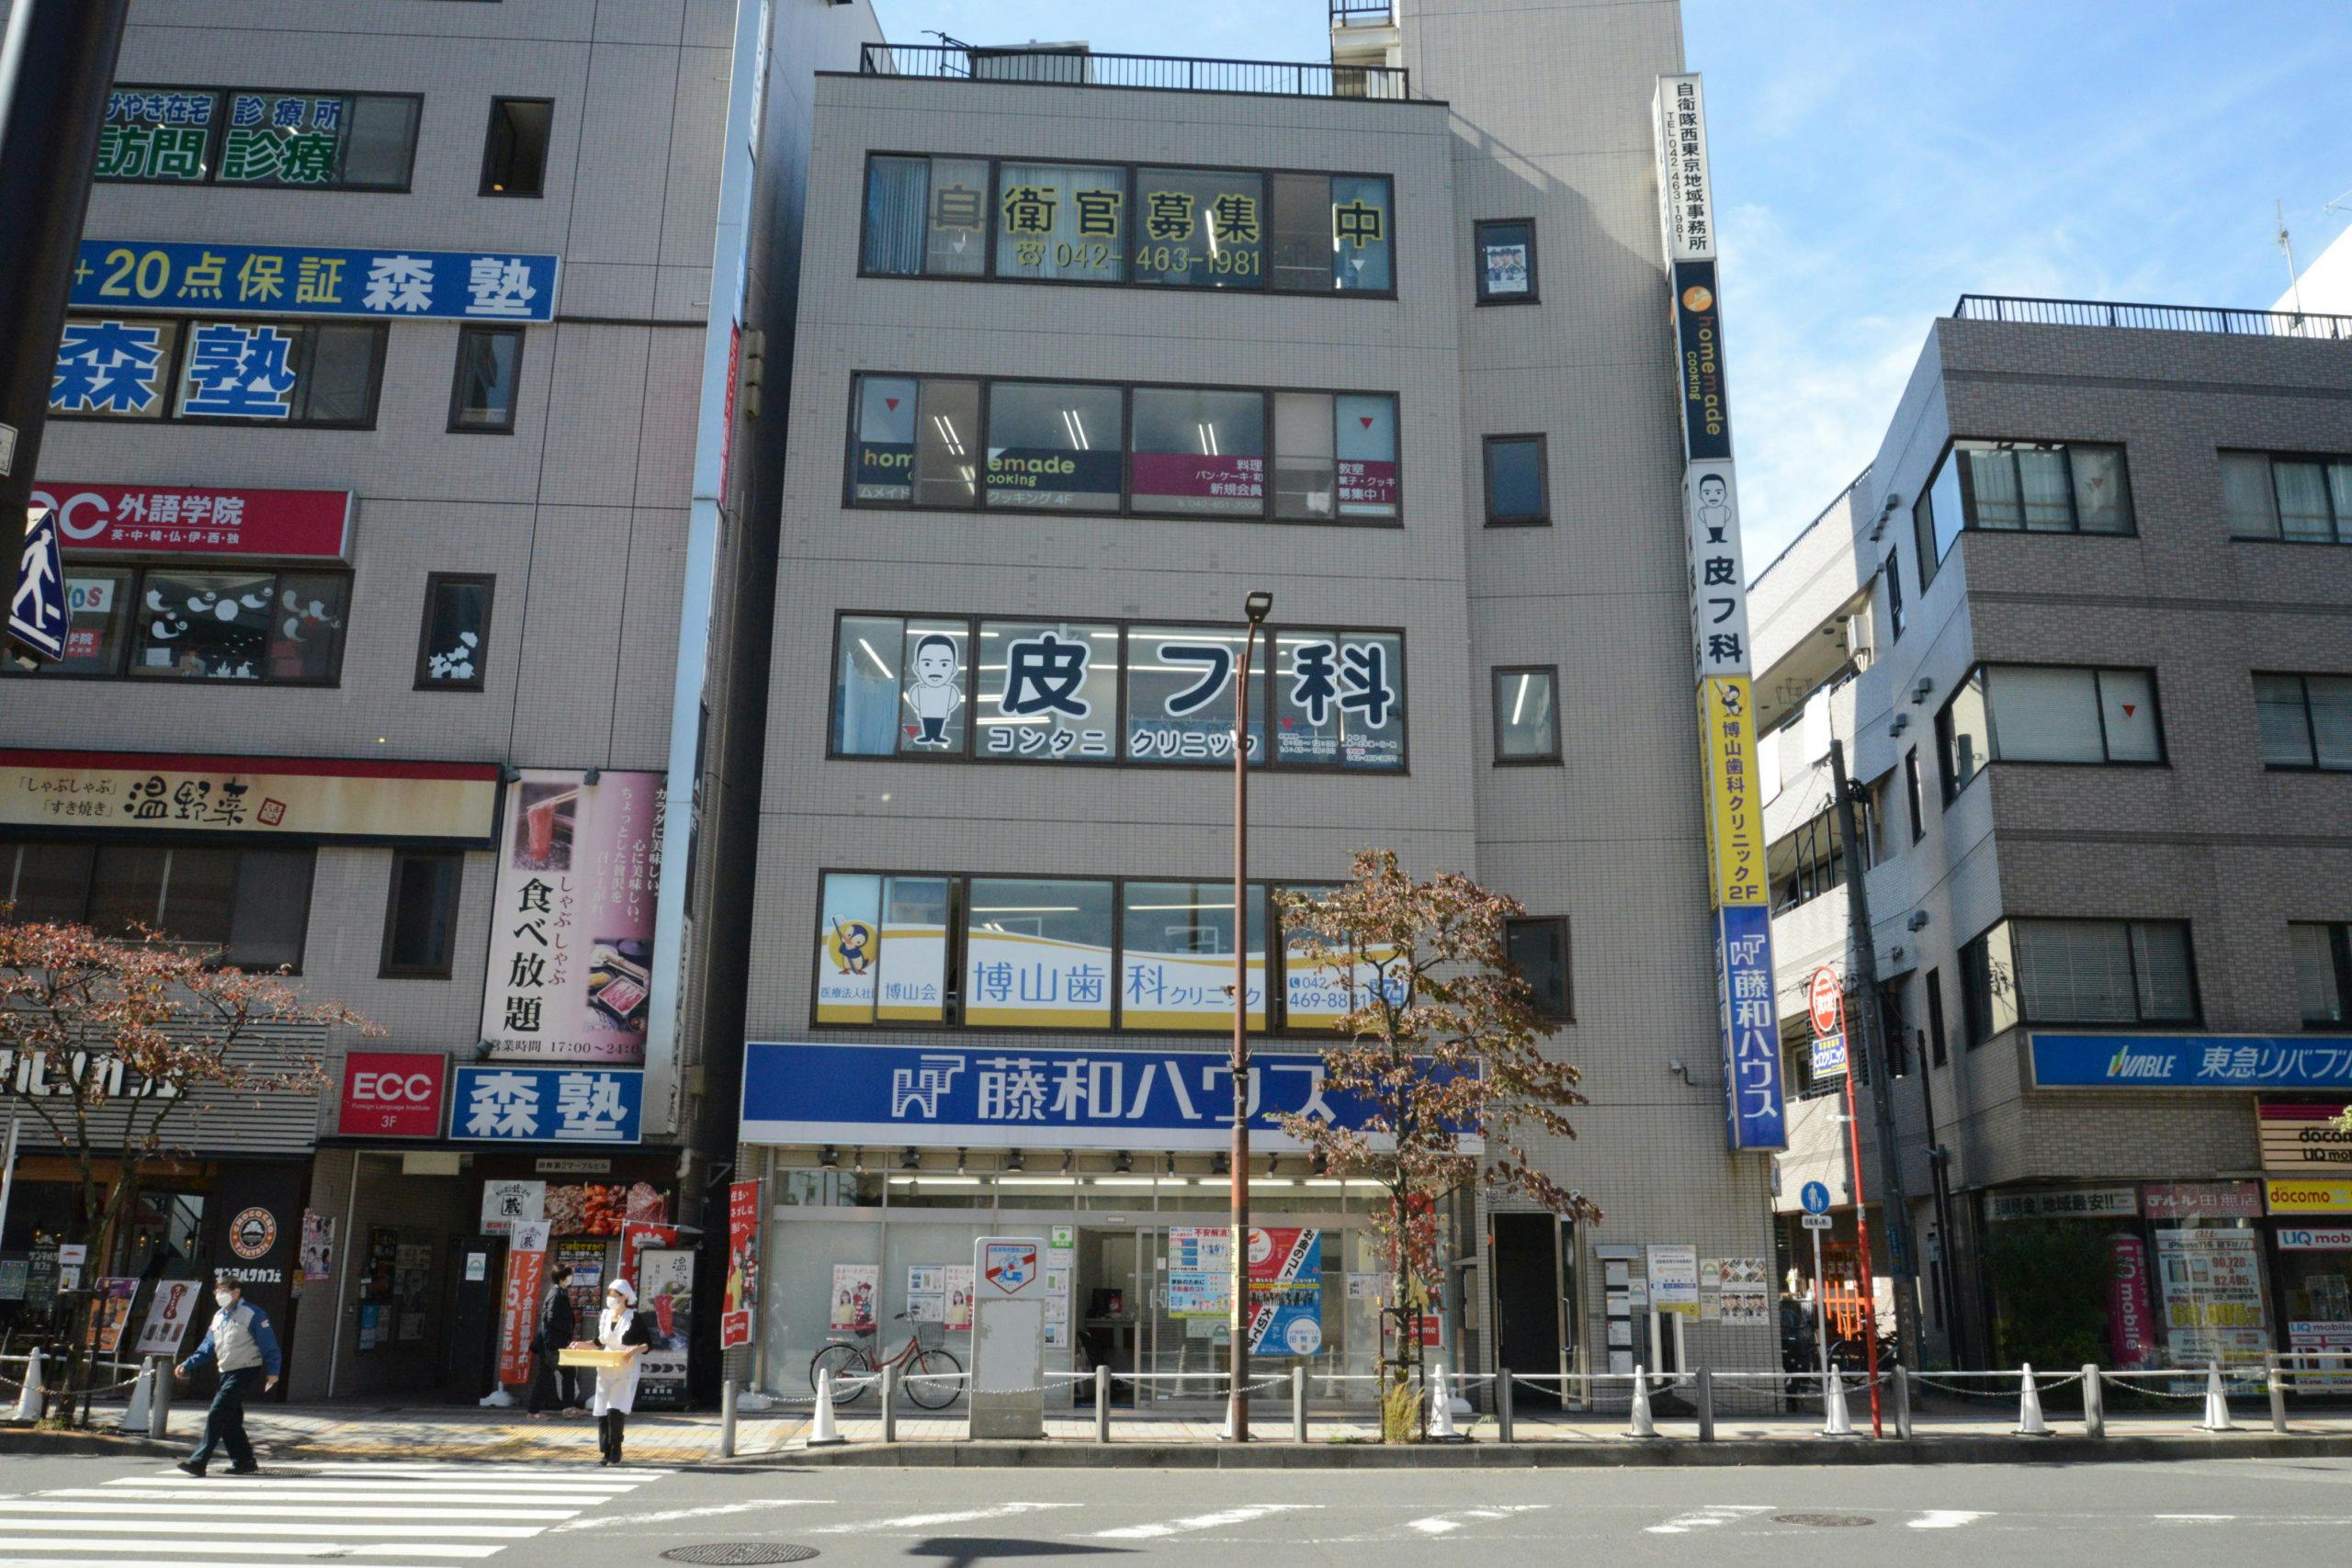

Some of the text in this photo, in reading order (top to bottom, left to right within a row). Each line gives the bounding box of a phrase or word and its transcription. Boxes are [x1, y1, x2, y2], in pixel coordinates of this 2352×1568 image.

[1678, 82, 1707, 251] 自衛隊西東京地域事務所
[936, 185, 1384, 250] 自衛官募集中
[361, 254, 537, 317] 森塾
[48, 320, 296, 420] 森塾
[1687, 351, 1701, 400] cooking
[1698, 315, 1724, 436] homemade
[1209, 483, 1263, 497] 新規会員
[1236, 458, 1364, 474] 料理 教室
[116, 492, 245, 525] 外語学院
[1056, 492, 1074, 504] 4F
[1704, 556, 1743, 664] 皮フ科
[999, 630, 1396, 729] 皮フ科
[988, 727, 1106, 757] コンタニ
[123, 776, 249, 826] 温野菜
[1723, 720, 1749, 883] 博山歯科クリニック
[1729, 886, 1758, 900] 2F
[503, 876, 554, 1033] 食べ放題
[548, 875, 574, 987] しゃぶしゃぶ
[820, 982, 937, 1000] 医療法人社 博山会
[972, 960, 1262, 1009] 博山歯科クリニク
[492, 1039, 542, 1054] 営業時間
[1733, 969, 1779, 1119] 藤和ハウス
[352, 1072, 433, 1101] ECC
[466, 1071, 628, 1140] 森塾
[976, 1057, 1338, 1122] 藤和ハウス
[381, 1115, 397, 1128] 3F
[2302, 1148, 2325, 1161] UQ
[2270, 1187, 2331, 1203] docomo
[2282, 1231, 2312, 1247] UQ
[2290, 1323, 2312, 1333] UQ
